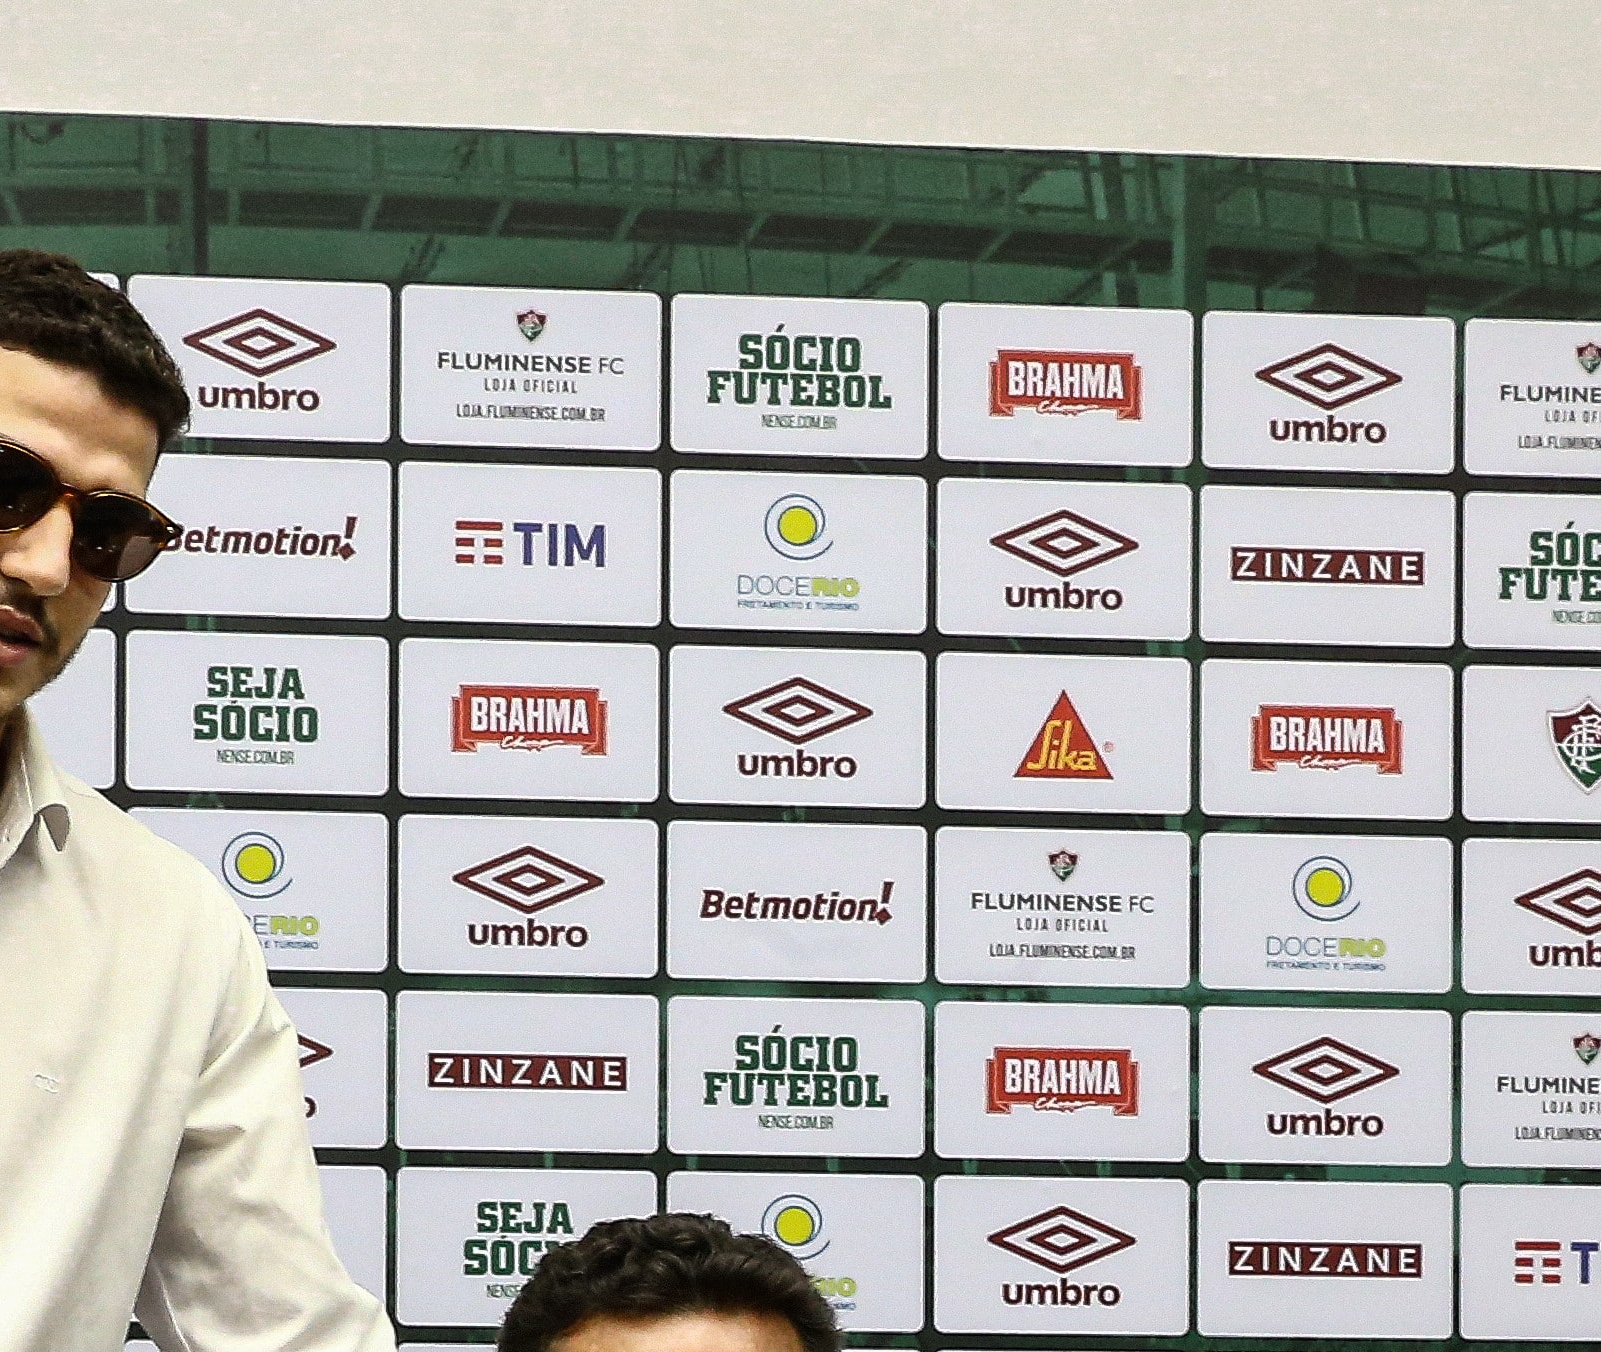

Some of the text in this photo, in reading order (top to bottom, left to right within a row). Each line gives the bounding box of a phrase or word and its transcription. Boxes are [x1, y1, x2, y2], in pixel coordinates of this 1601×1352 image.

[437, 351, 624, 374] FLUMINENSE FC
[738, 324, 861, 373] SÓCIO
[706, 370, 892, 409] FUTEBOL
[1009, 361, 1123, 398] BRAHMA
[198, 383, 320, 413] umbro
[1269, 415, 1387, 443] umbro
[514, 523, 604, 566] TIM
[1237, 552, 1418, 580] ZINZANE
[1005, 581, 1123, 610] umbro
[207, 666, 305, 700] SEJA
[193, 700, 319, 743] SÓCIO
[470, 696, 588, 734] BRAHMA
[737, 749, 857, 778] umbro
[700, 881, 895, 925] Betmotion!
[971, 890, 1154, 914] FLUMINENSE FC
[467, 918, 588, 947] umbro
[434, 1058, 621, 1086] ZINZANE
[1005, 1058, 1121, 1095] BRAHMA
[1234, 1247, 1416, 1273] ZINZANE
[1002, 1278, 1121, 1306] umbro
